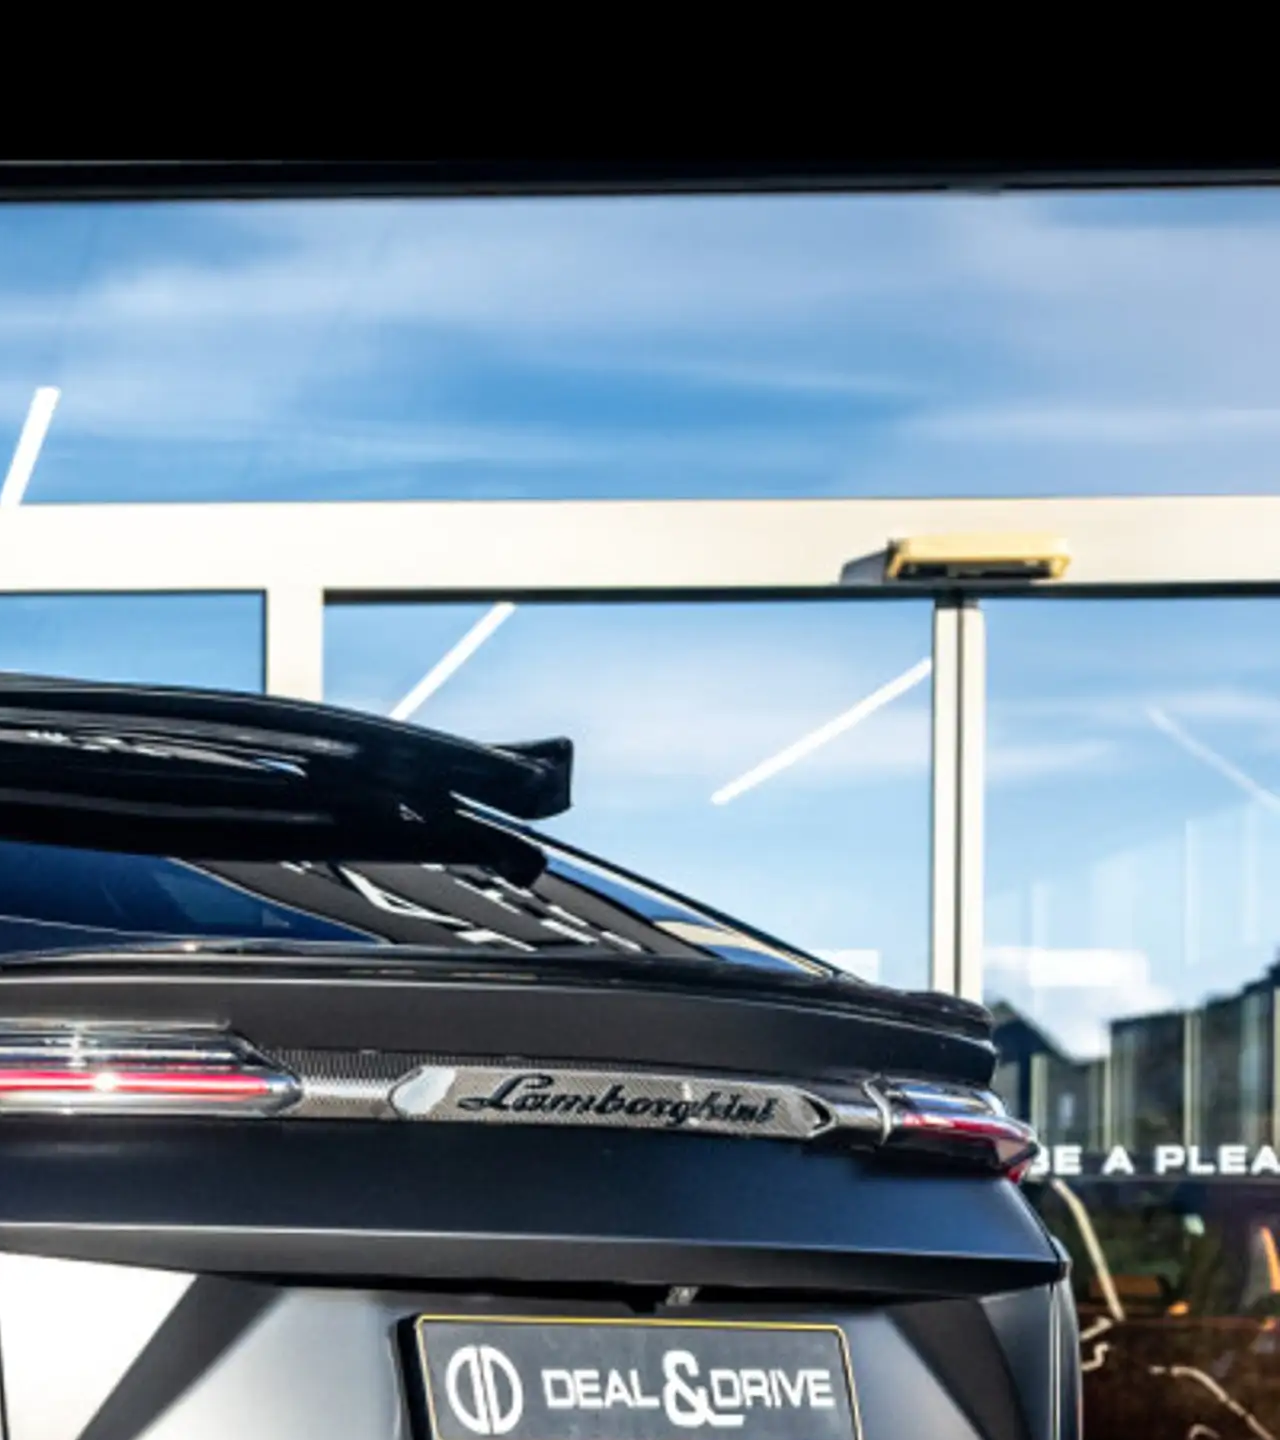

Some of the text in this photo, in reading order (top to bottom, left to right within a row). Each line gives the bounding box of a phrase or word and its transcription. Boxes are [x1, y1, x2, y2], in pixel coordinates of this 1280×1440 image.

[458, 1073, 775, 1126] Lamborghini
[1101, 1144, 1135, 1176] A
[1154, 1144, 1280, 1176] PLEA
